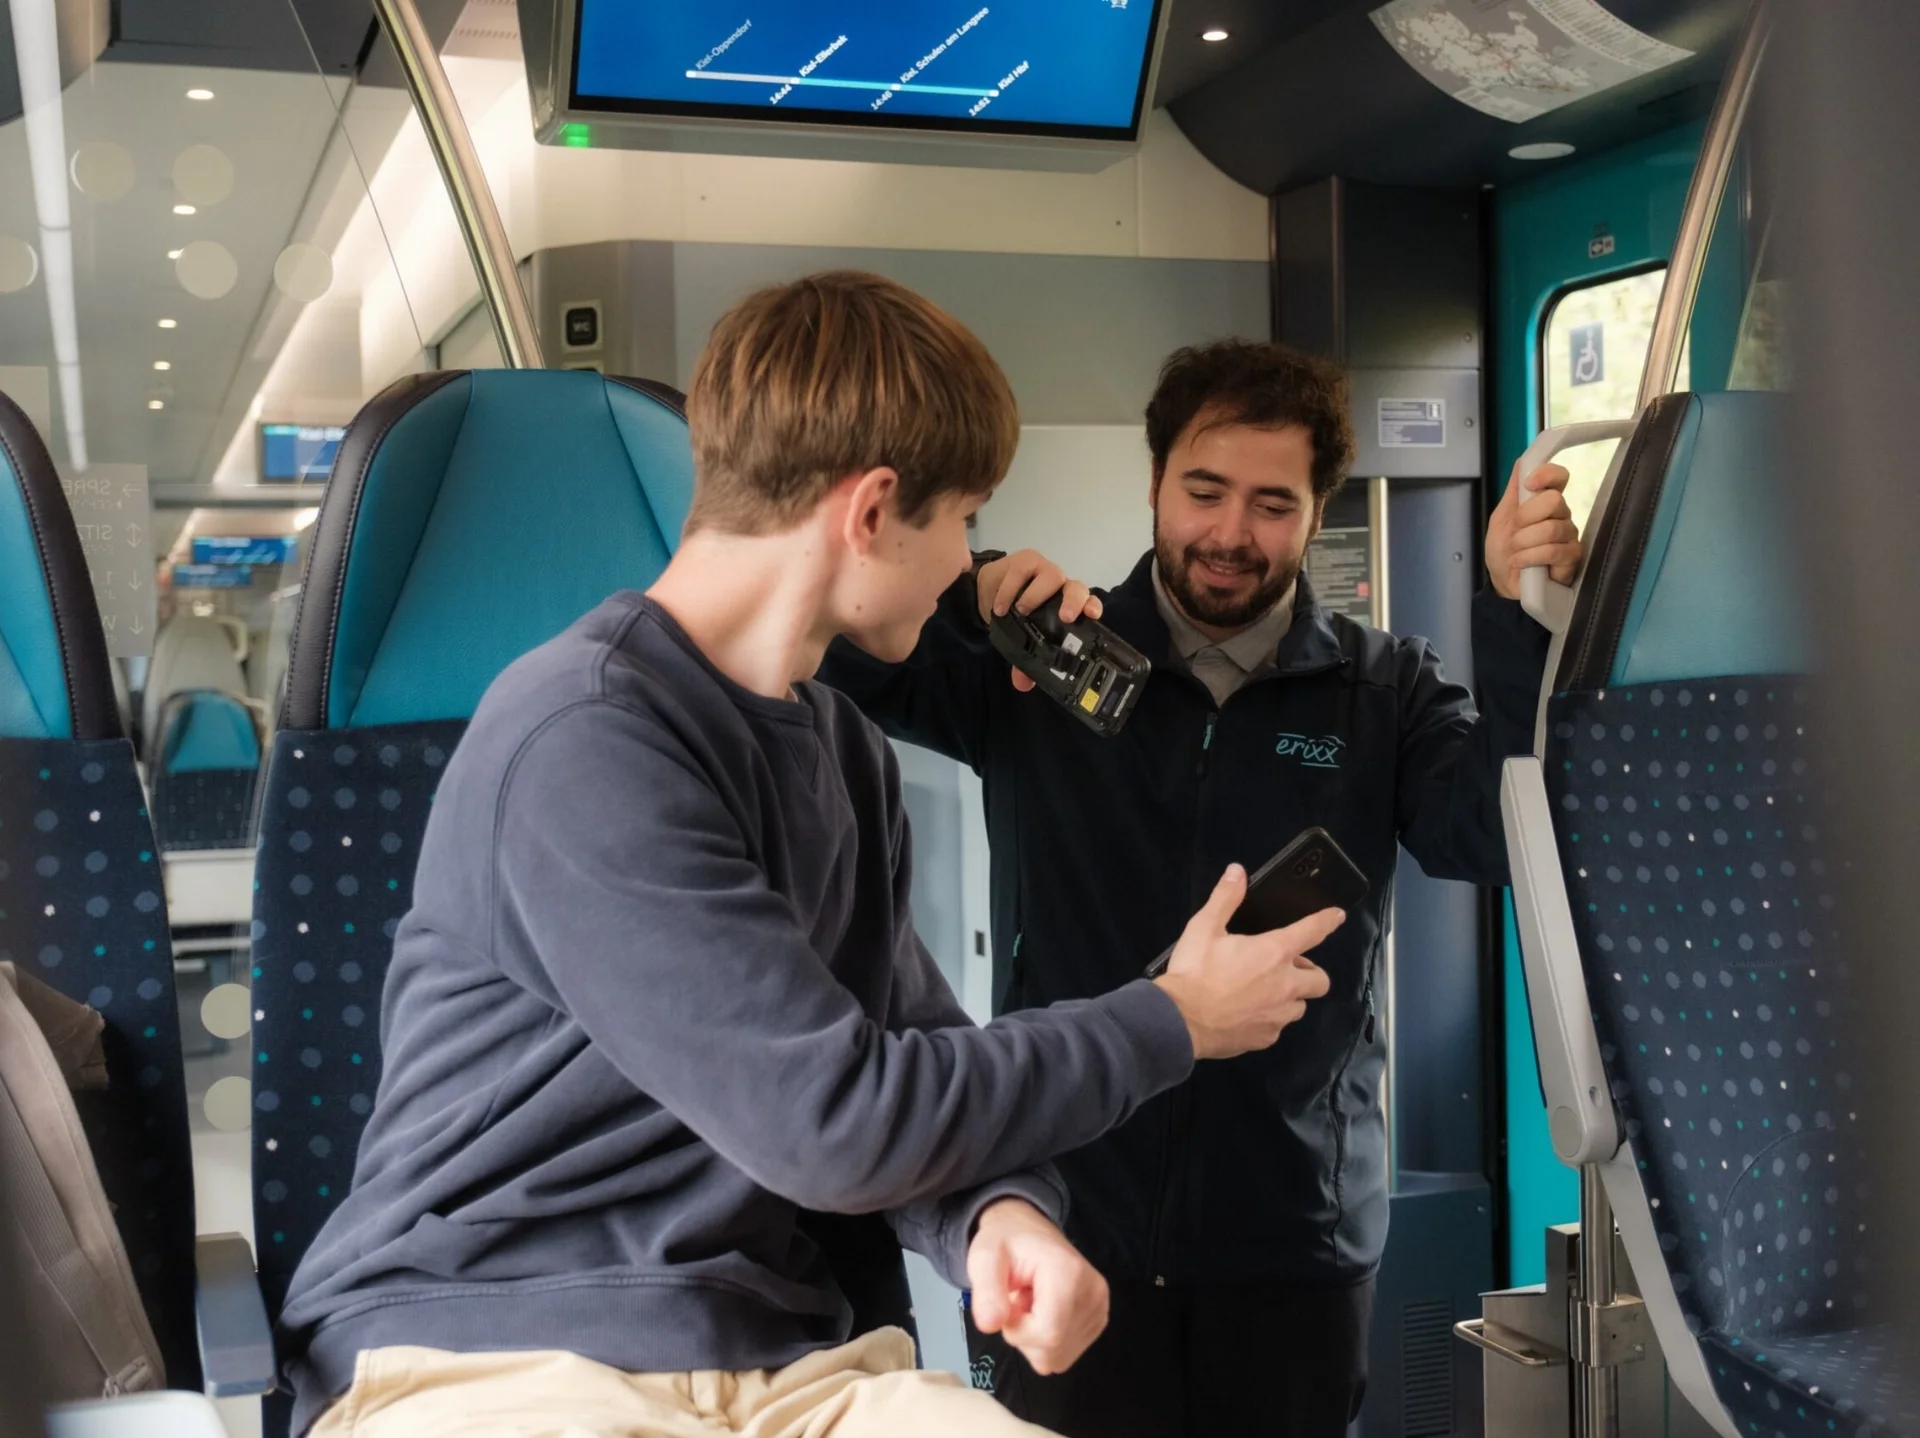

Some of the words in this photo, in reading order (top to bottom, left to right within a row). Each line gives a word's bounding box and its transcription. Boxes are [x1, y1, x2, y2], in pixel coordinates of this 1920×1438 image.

[695, 18, 752, 70] Kiel-Oppendorf
[915, 43, 947, 70] Schulen
[945, 32, 960, 46] am
[956, 7, 989, 36] Langsee
[799, 35, 848, 77] Kiel-Ellerbek
[997, 72, 1016, 90] Kiel
[1012, 60, 1030, 78] Hbf
[769, 84, 792, 105] 14:44
[870, 90, 893, 111] 14:46
[968, 96, 991, 117] 14:51
[1276, 736, 1341, 764] erixx
